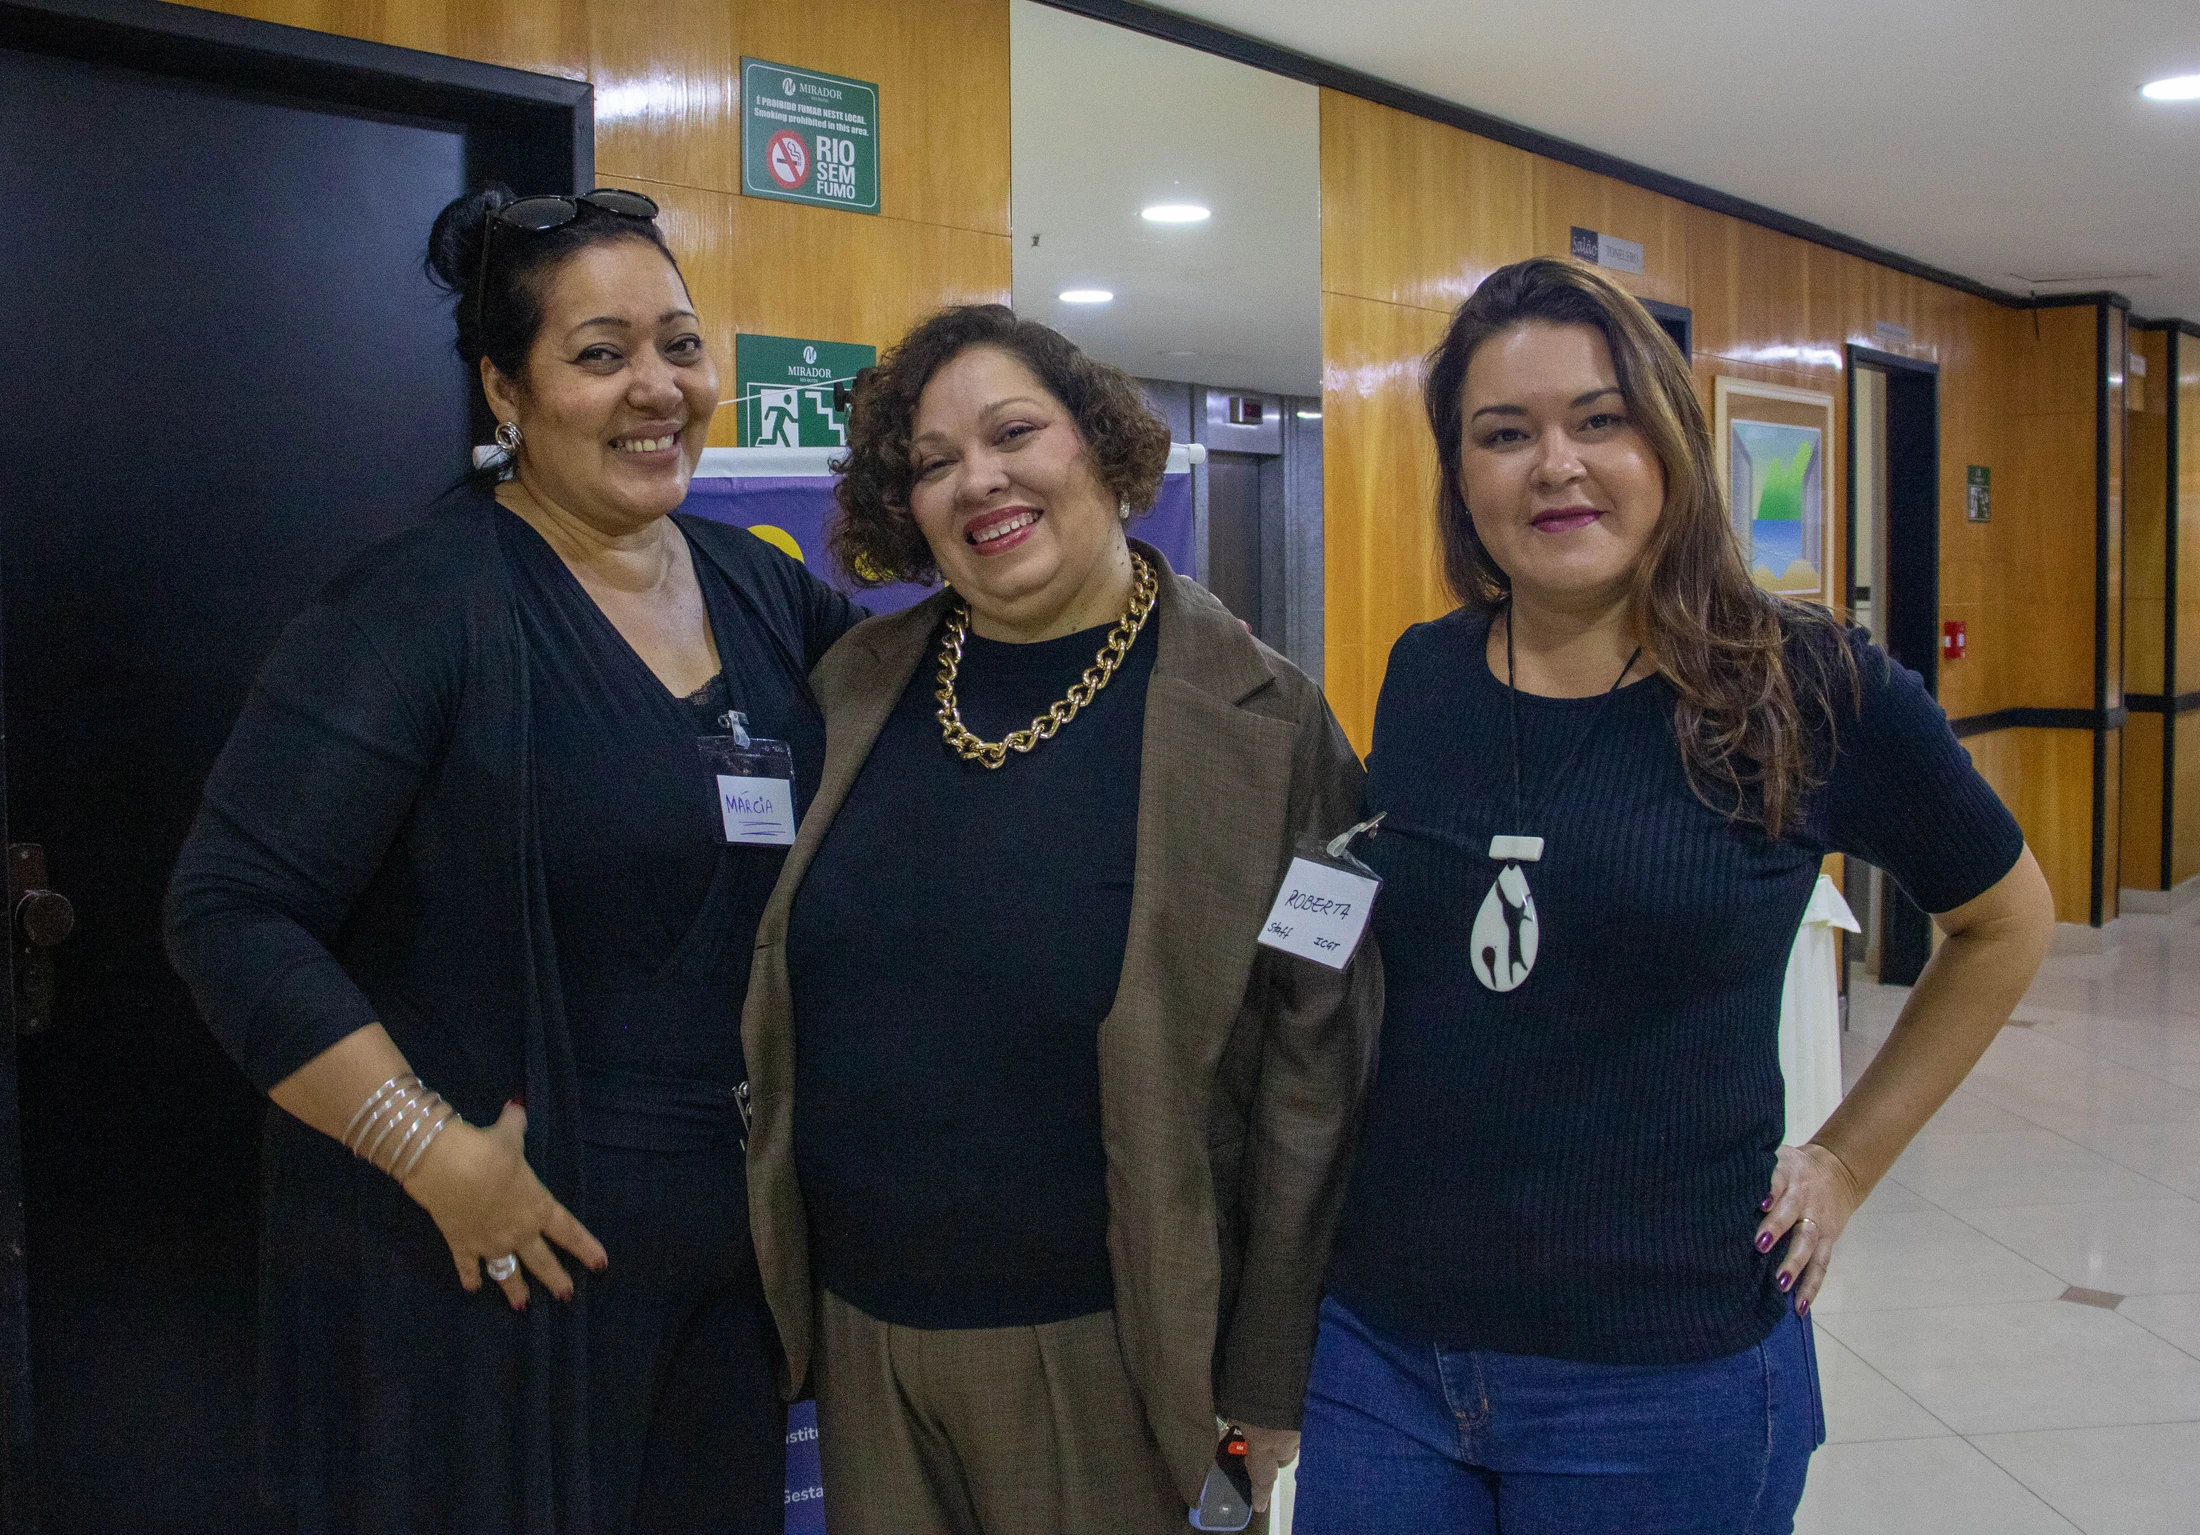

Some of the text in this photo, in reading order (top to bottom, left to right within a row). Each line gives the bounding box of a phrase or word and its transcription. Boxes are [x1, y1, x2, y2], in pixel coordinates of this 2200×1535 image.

[799, 83, 843, 100] MIRADOR
[754, 107, 869, 136] Smoking prohibited in this area.
[762, 98, 797, 112] PROIBIDO
[797, 104, 822, 116] FUMAR
[823, 108, 844, 120] NESTE
[844, 113, 867, 125] LOCAL.
[816, 135, 855, 166] RIO
[816, 162, 856, 185] SEM
[816, 181, 856, 200] FUMO
[788, 365, 832, 379] MIRADOR
[1284, 889, 1352, 920] ROBERTA
